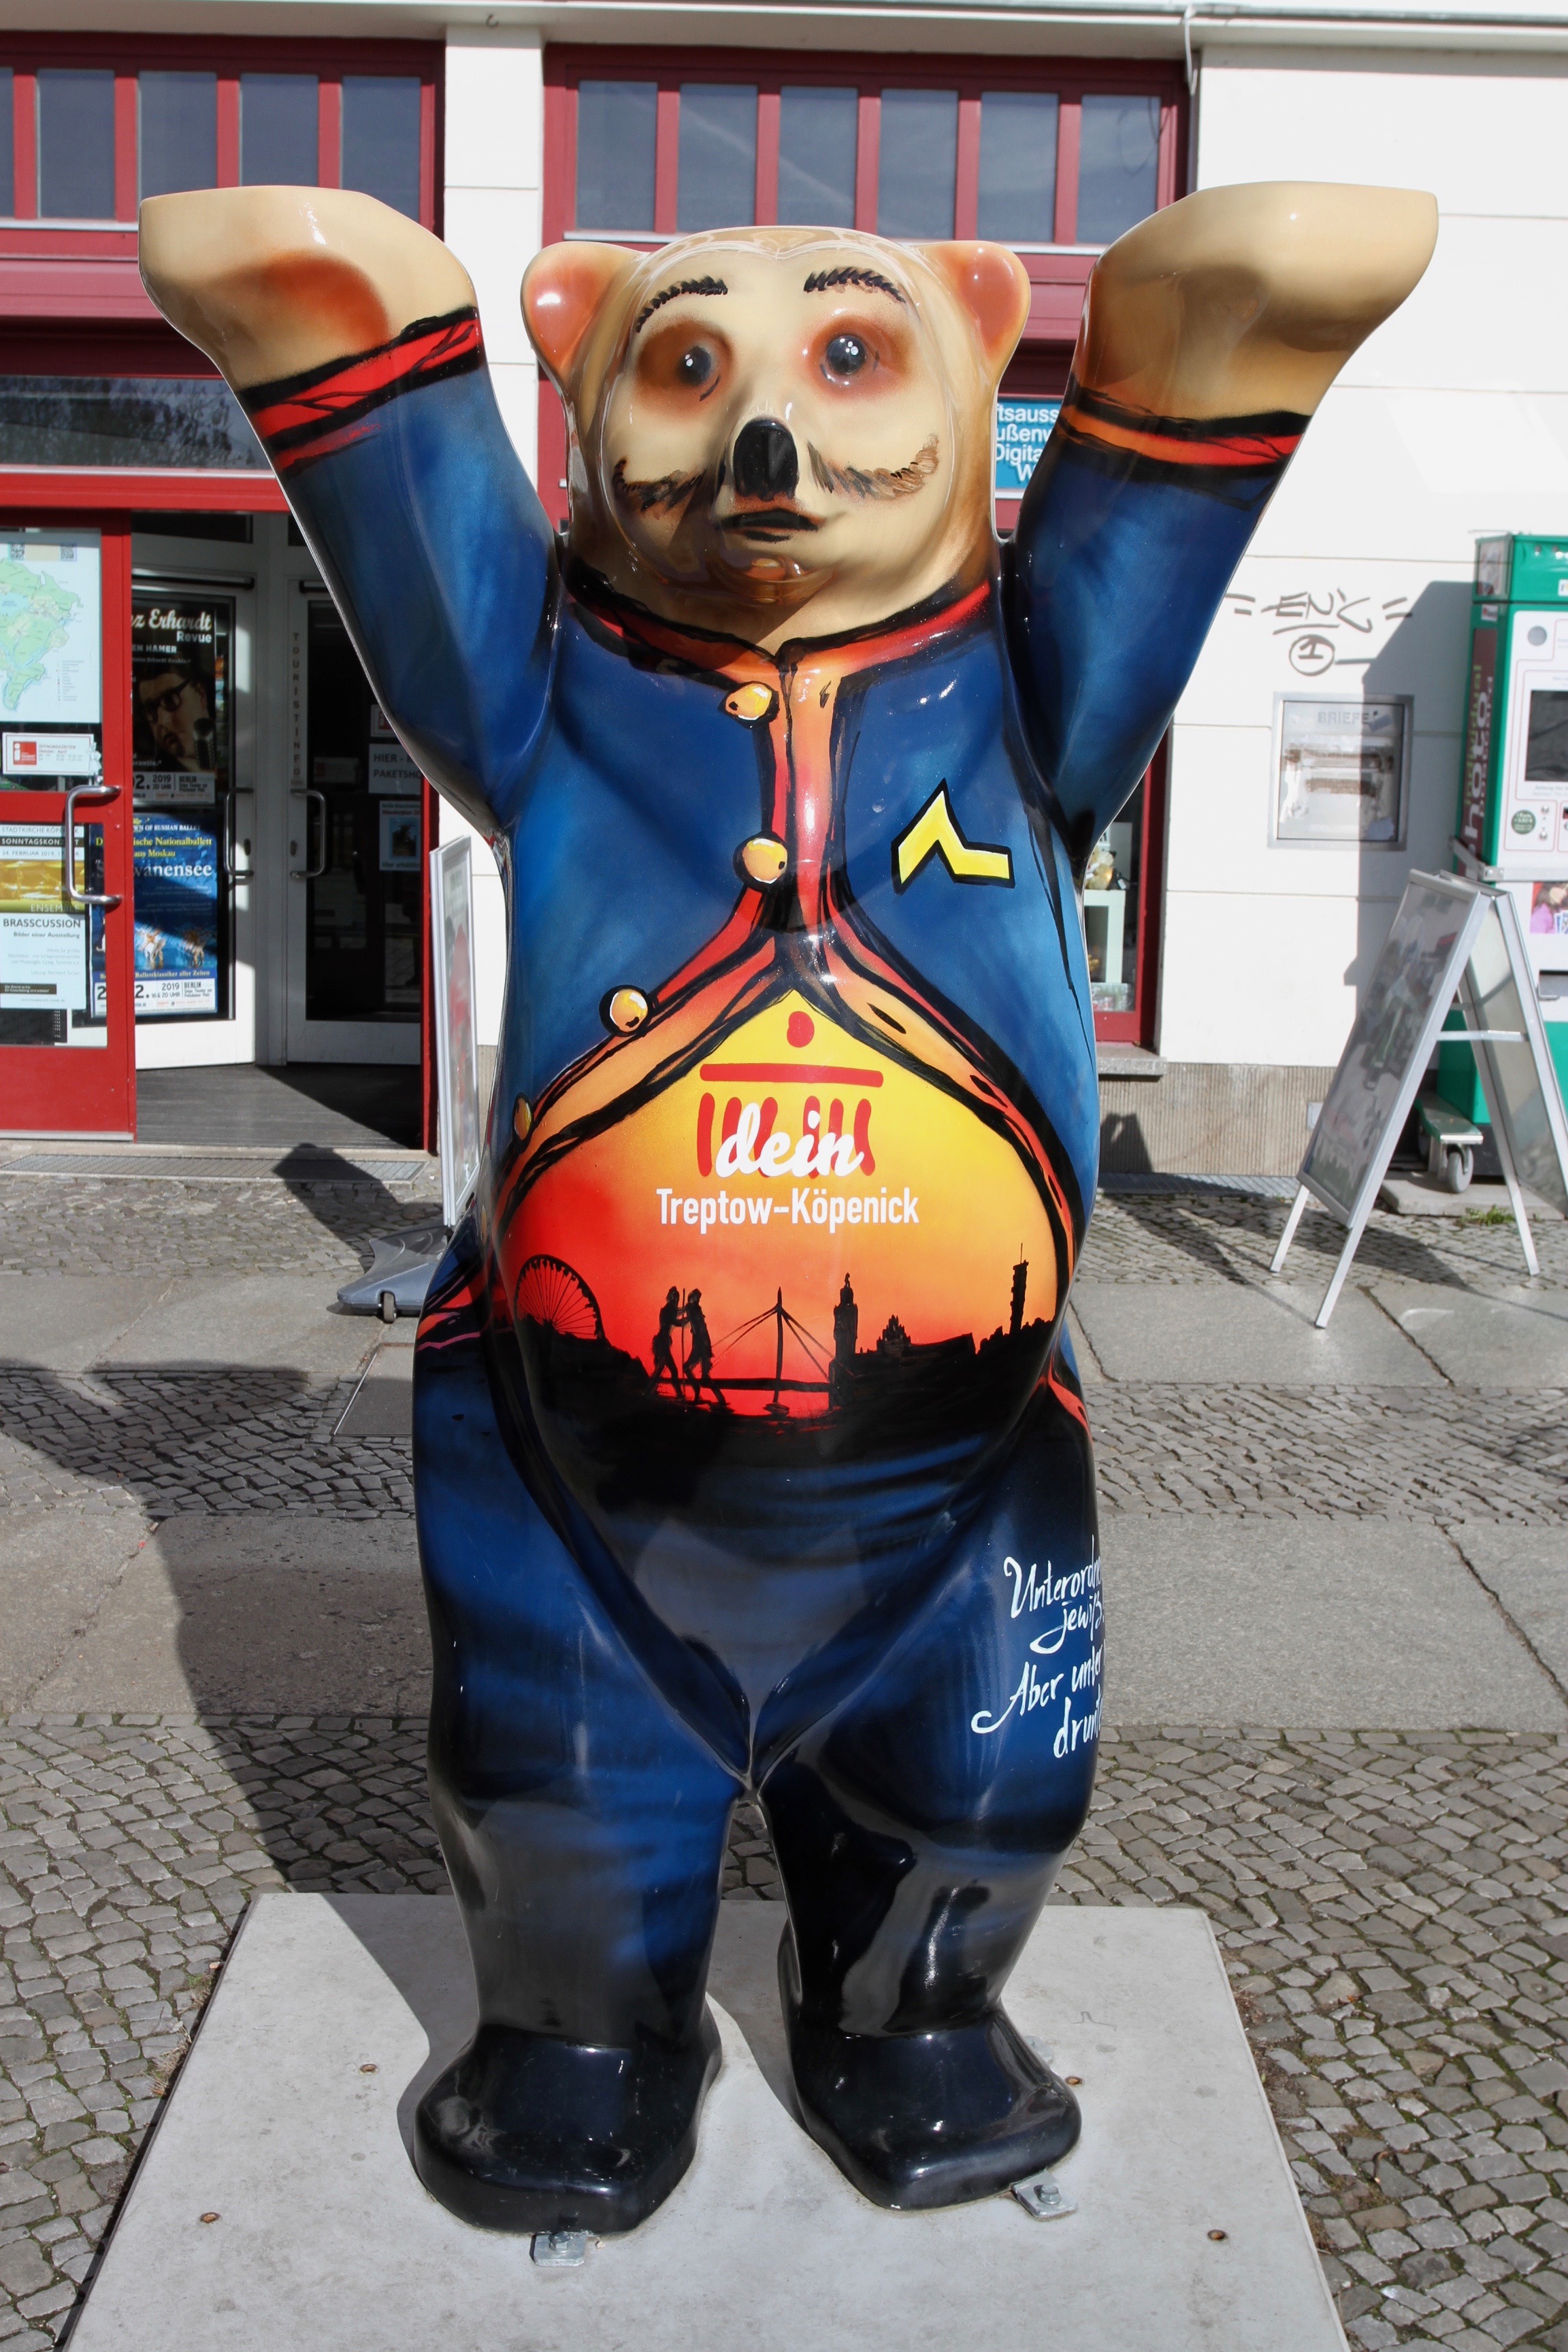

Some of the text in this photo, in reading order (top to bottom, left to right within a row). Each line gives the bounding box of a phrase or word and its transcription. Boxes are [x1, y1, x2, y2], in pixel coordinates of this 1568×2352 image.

[997, 403, 1060, 423] tsauss
[148, 608, 212, 631] Erhardt
[177, 630, 212, 643] Revue
[146, 644, 177, 653] HAMER
[1318, 710, 1370, 725] BRIEFE
[374, 753, 397, 763] HIER
[152, 774, 171, 783] 2019
[155, 837, 212, 846] Nationalballett
[148, 849, 176, 858] Moskau
[3, 919, 81, 928] BRASSCUSSION
[162, 982, 180, 992] 2019
[184, 981, 201, 989] BERLIN
[715, 1102, 865, 1178] dein
[656, 1187, 919, 1235] Treptow-Köpenick
[970, 1661, 1064, 1734] Aber
